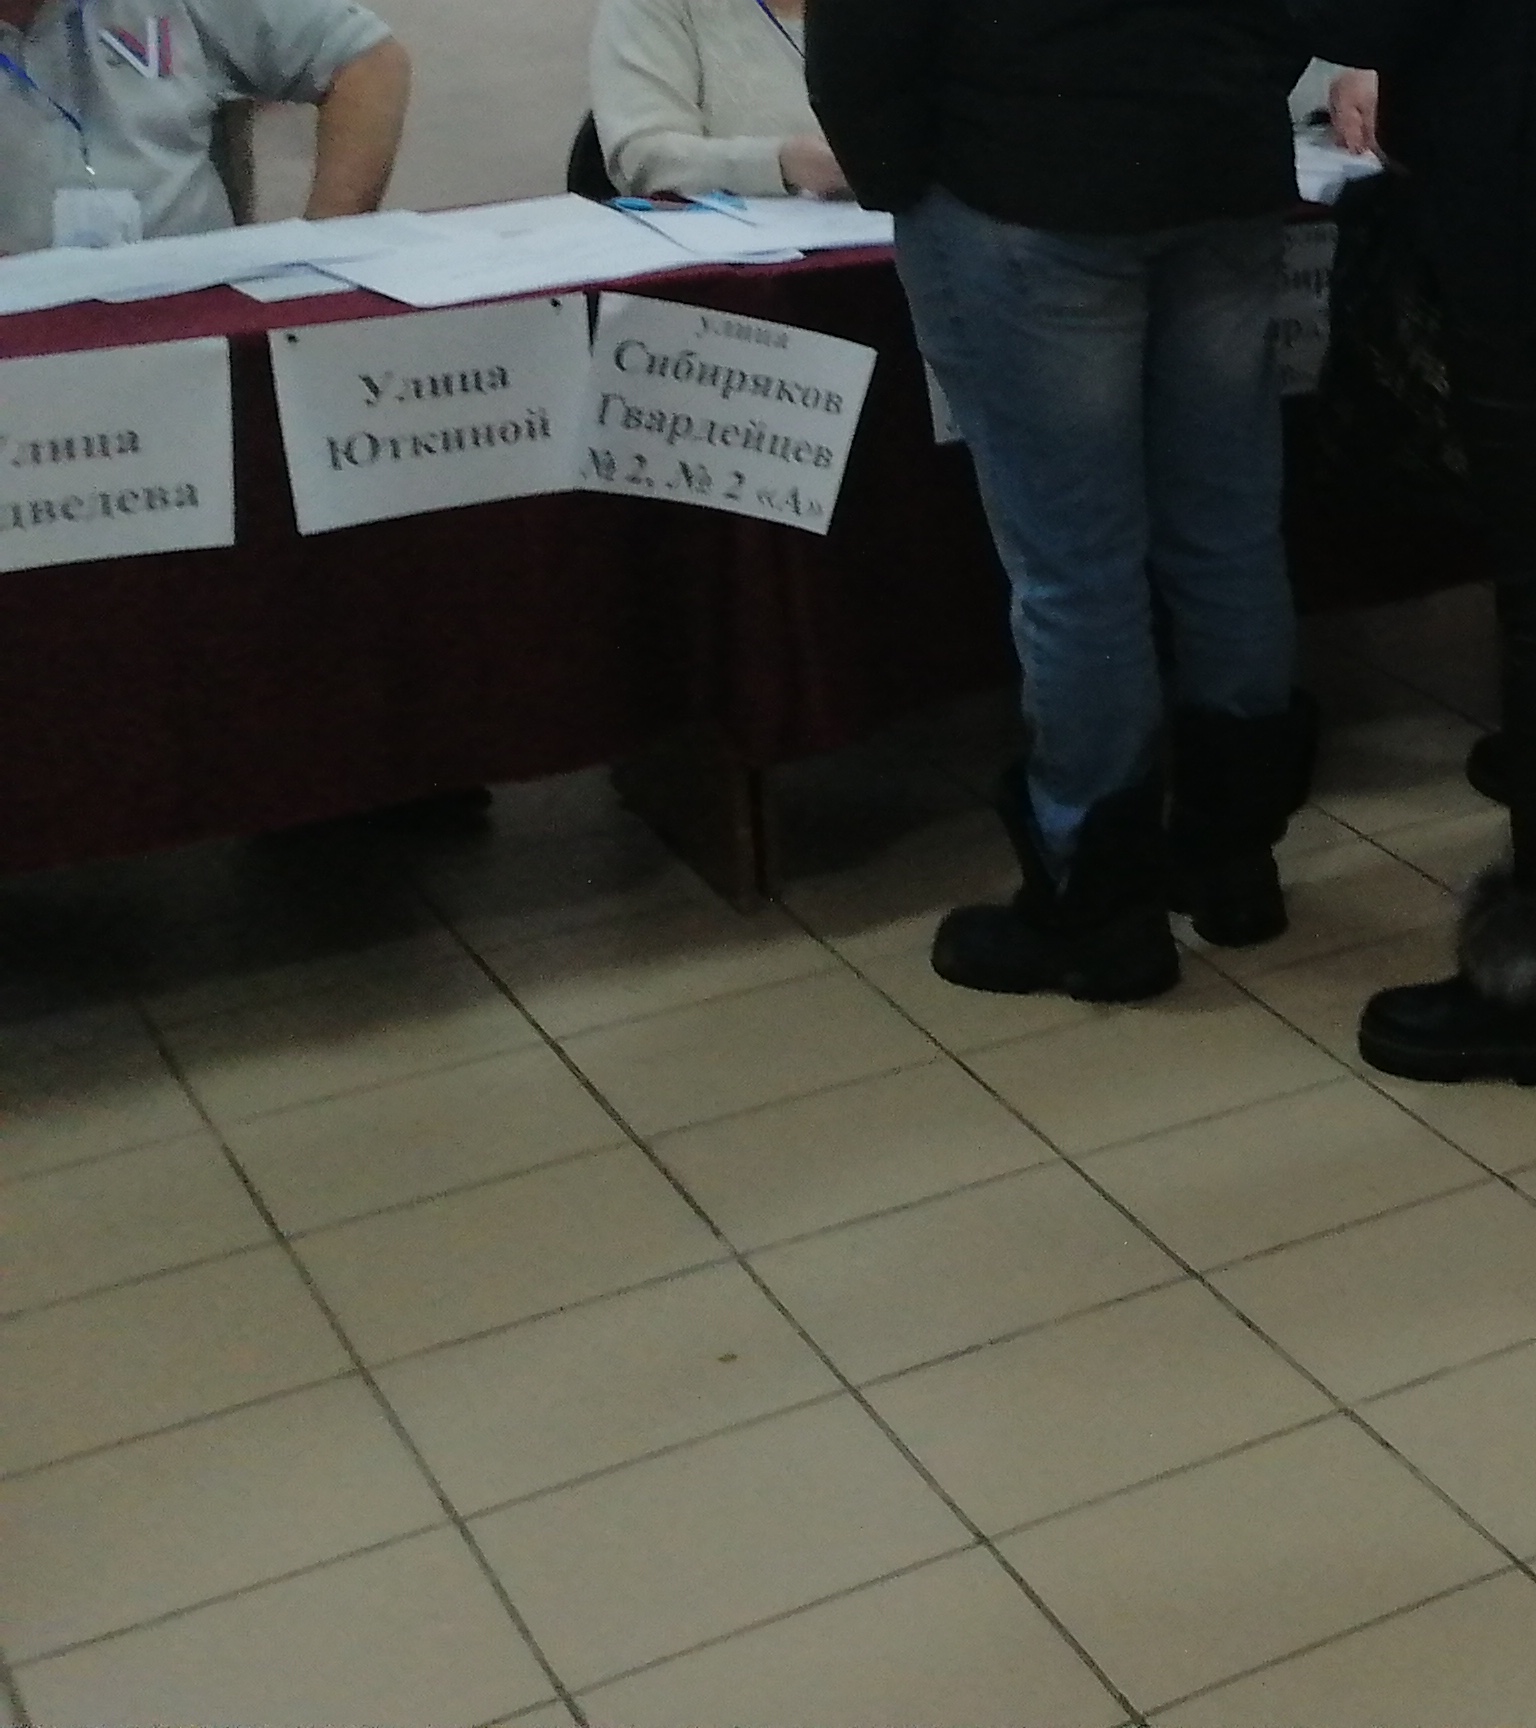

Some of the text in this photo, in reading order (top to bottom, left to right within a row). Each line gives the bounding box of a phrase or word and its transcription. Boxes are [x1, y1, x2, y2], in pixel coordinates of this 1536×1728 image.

[358, 364, 511, 408] Улица
[613, 338, 844, 415] Сибиряков
[0, 429, 141, 469] лица
[325, 405, 552, 472] Юткиной
[599, 391, 835, 469] Гвардейцев
[721, 470, 747, 502] 2
